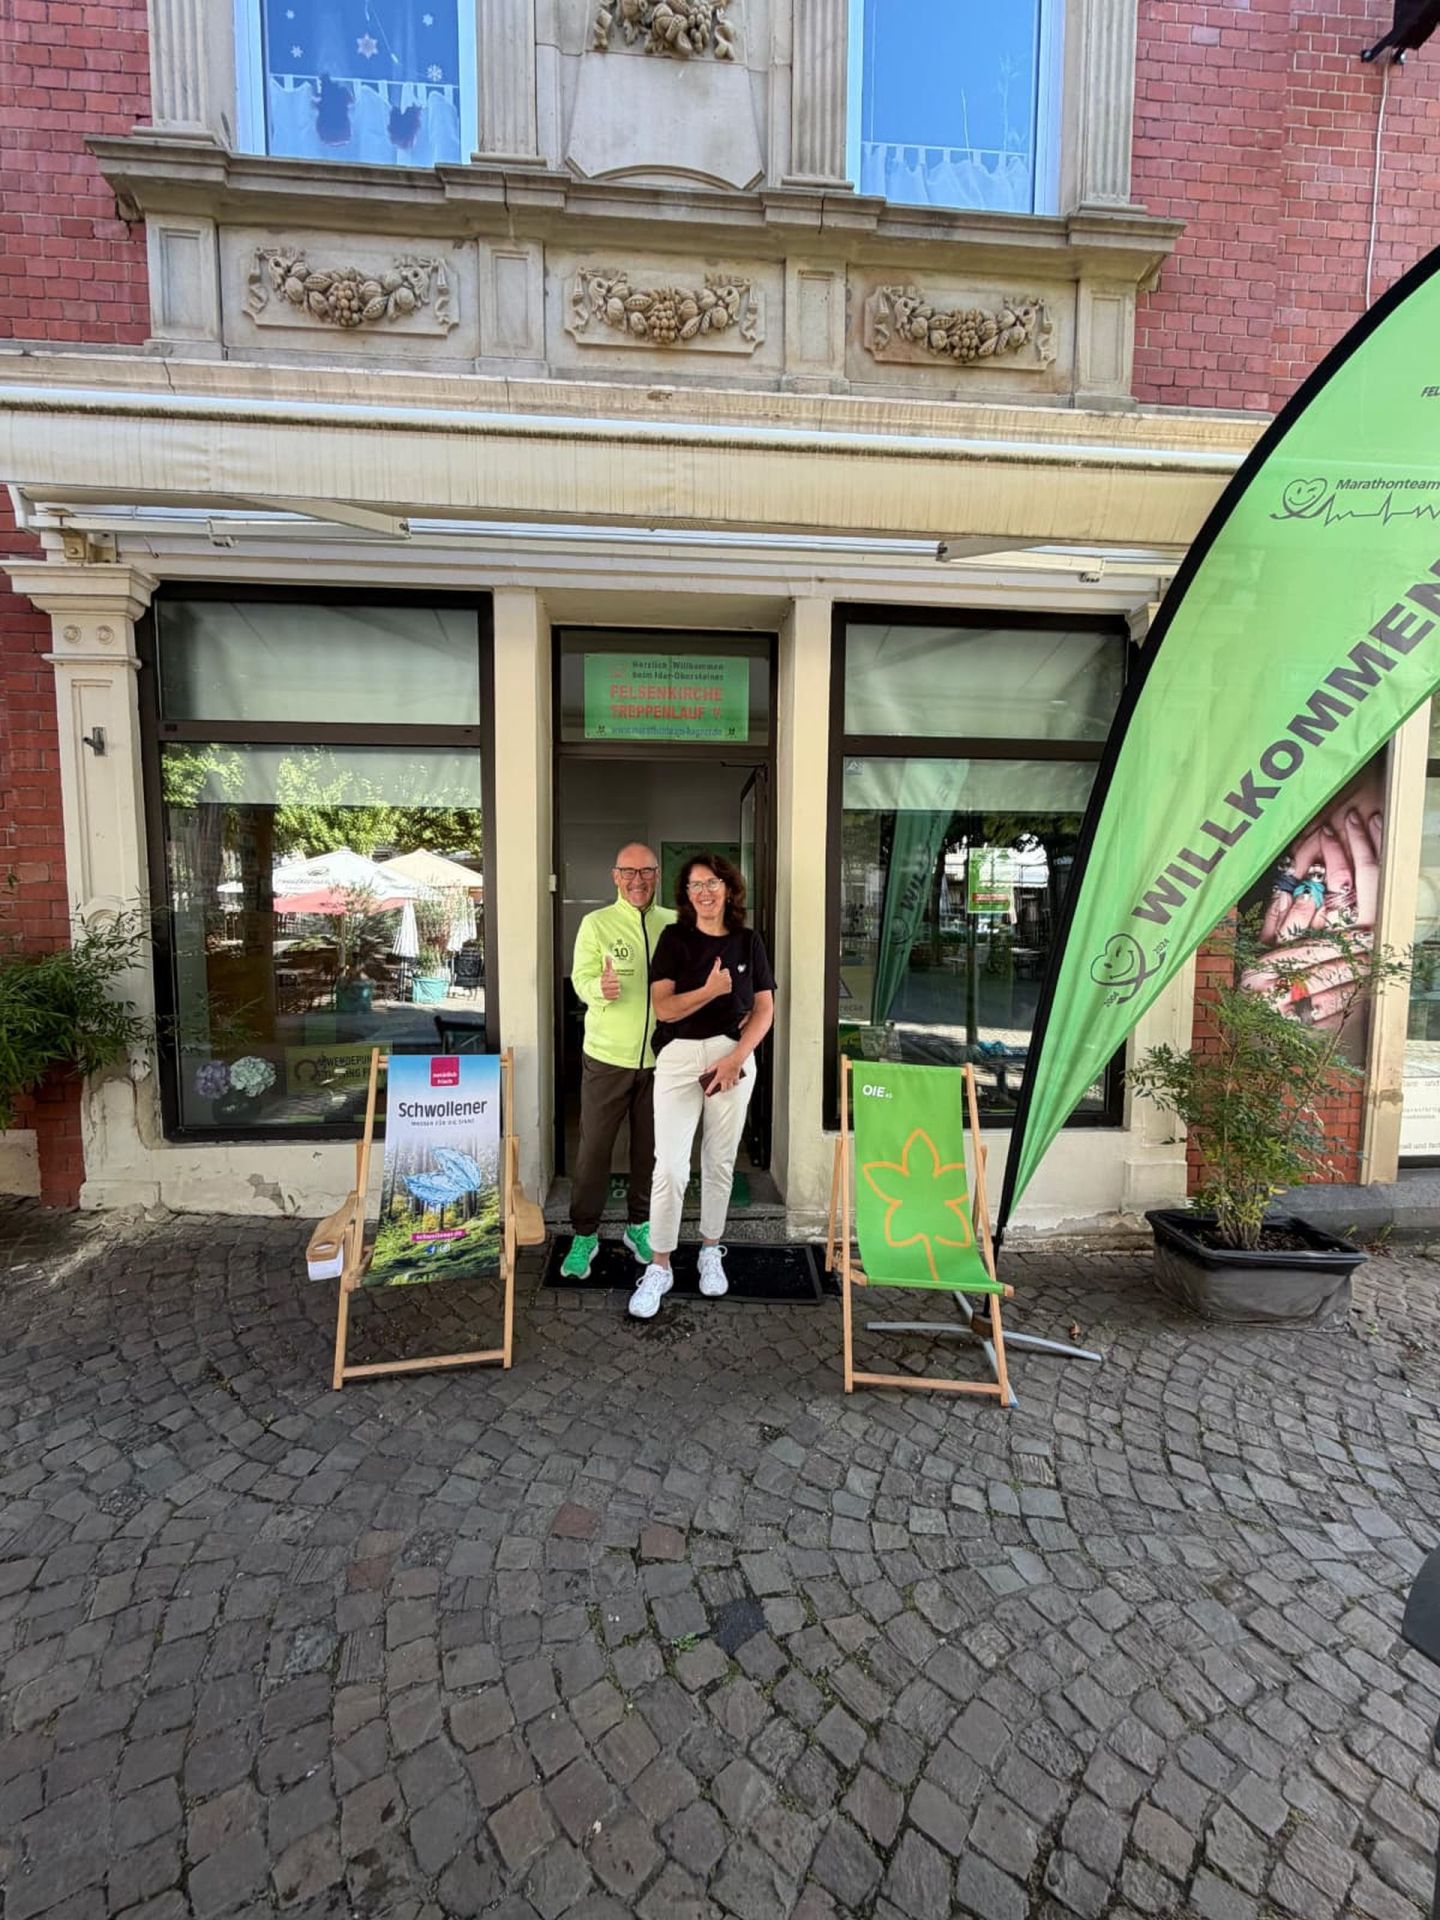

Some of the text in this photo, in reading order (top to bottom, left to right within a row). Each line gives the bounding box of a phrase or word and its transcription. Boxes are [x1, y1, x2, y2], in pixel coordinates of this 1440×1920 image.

[1335, 477, 1440, 490] Marathonteam
[673, 661, 724, 671] Willkommen
[610, 684, 723, 701] FELSENKIRCHE
[610, 704, 704, 719] TREPPENLAUF
[1131, 557, 1440, 926] WILLKOMMEN
[614, 947, 629, 958] 10
[862, 1084, 886, 1098] OIE
[398, 1100, 488, 1118] Schwollener
